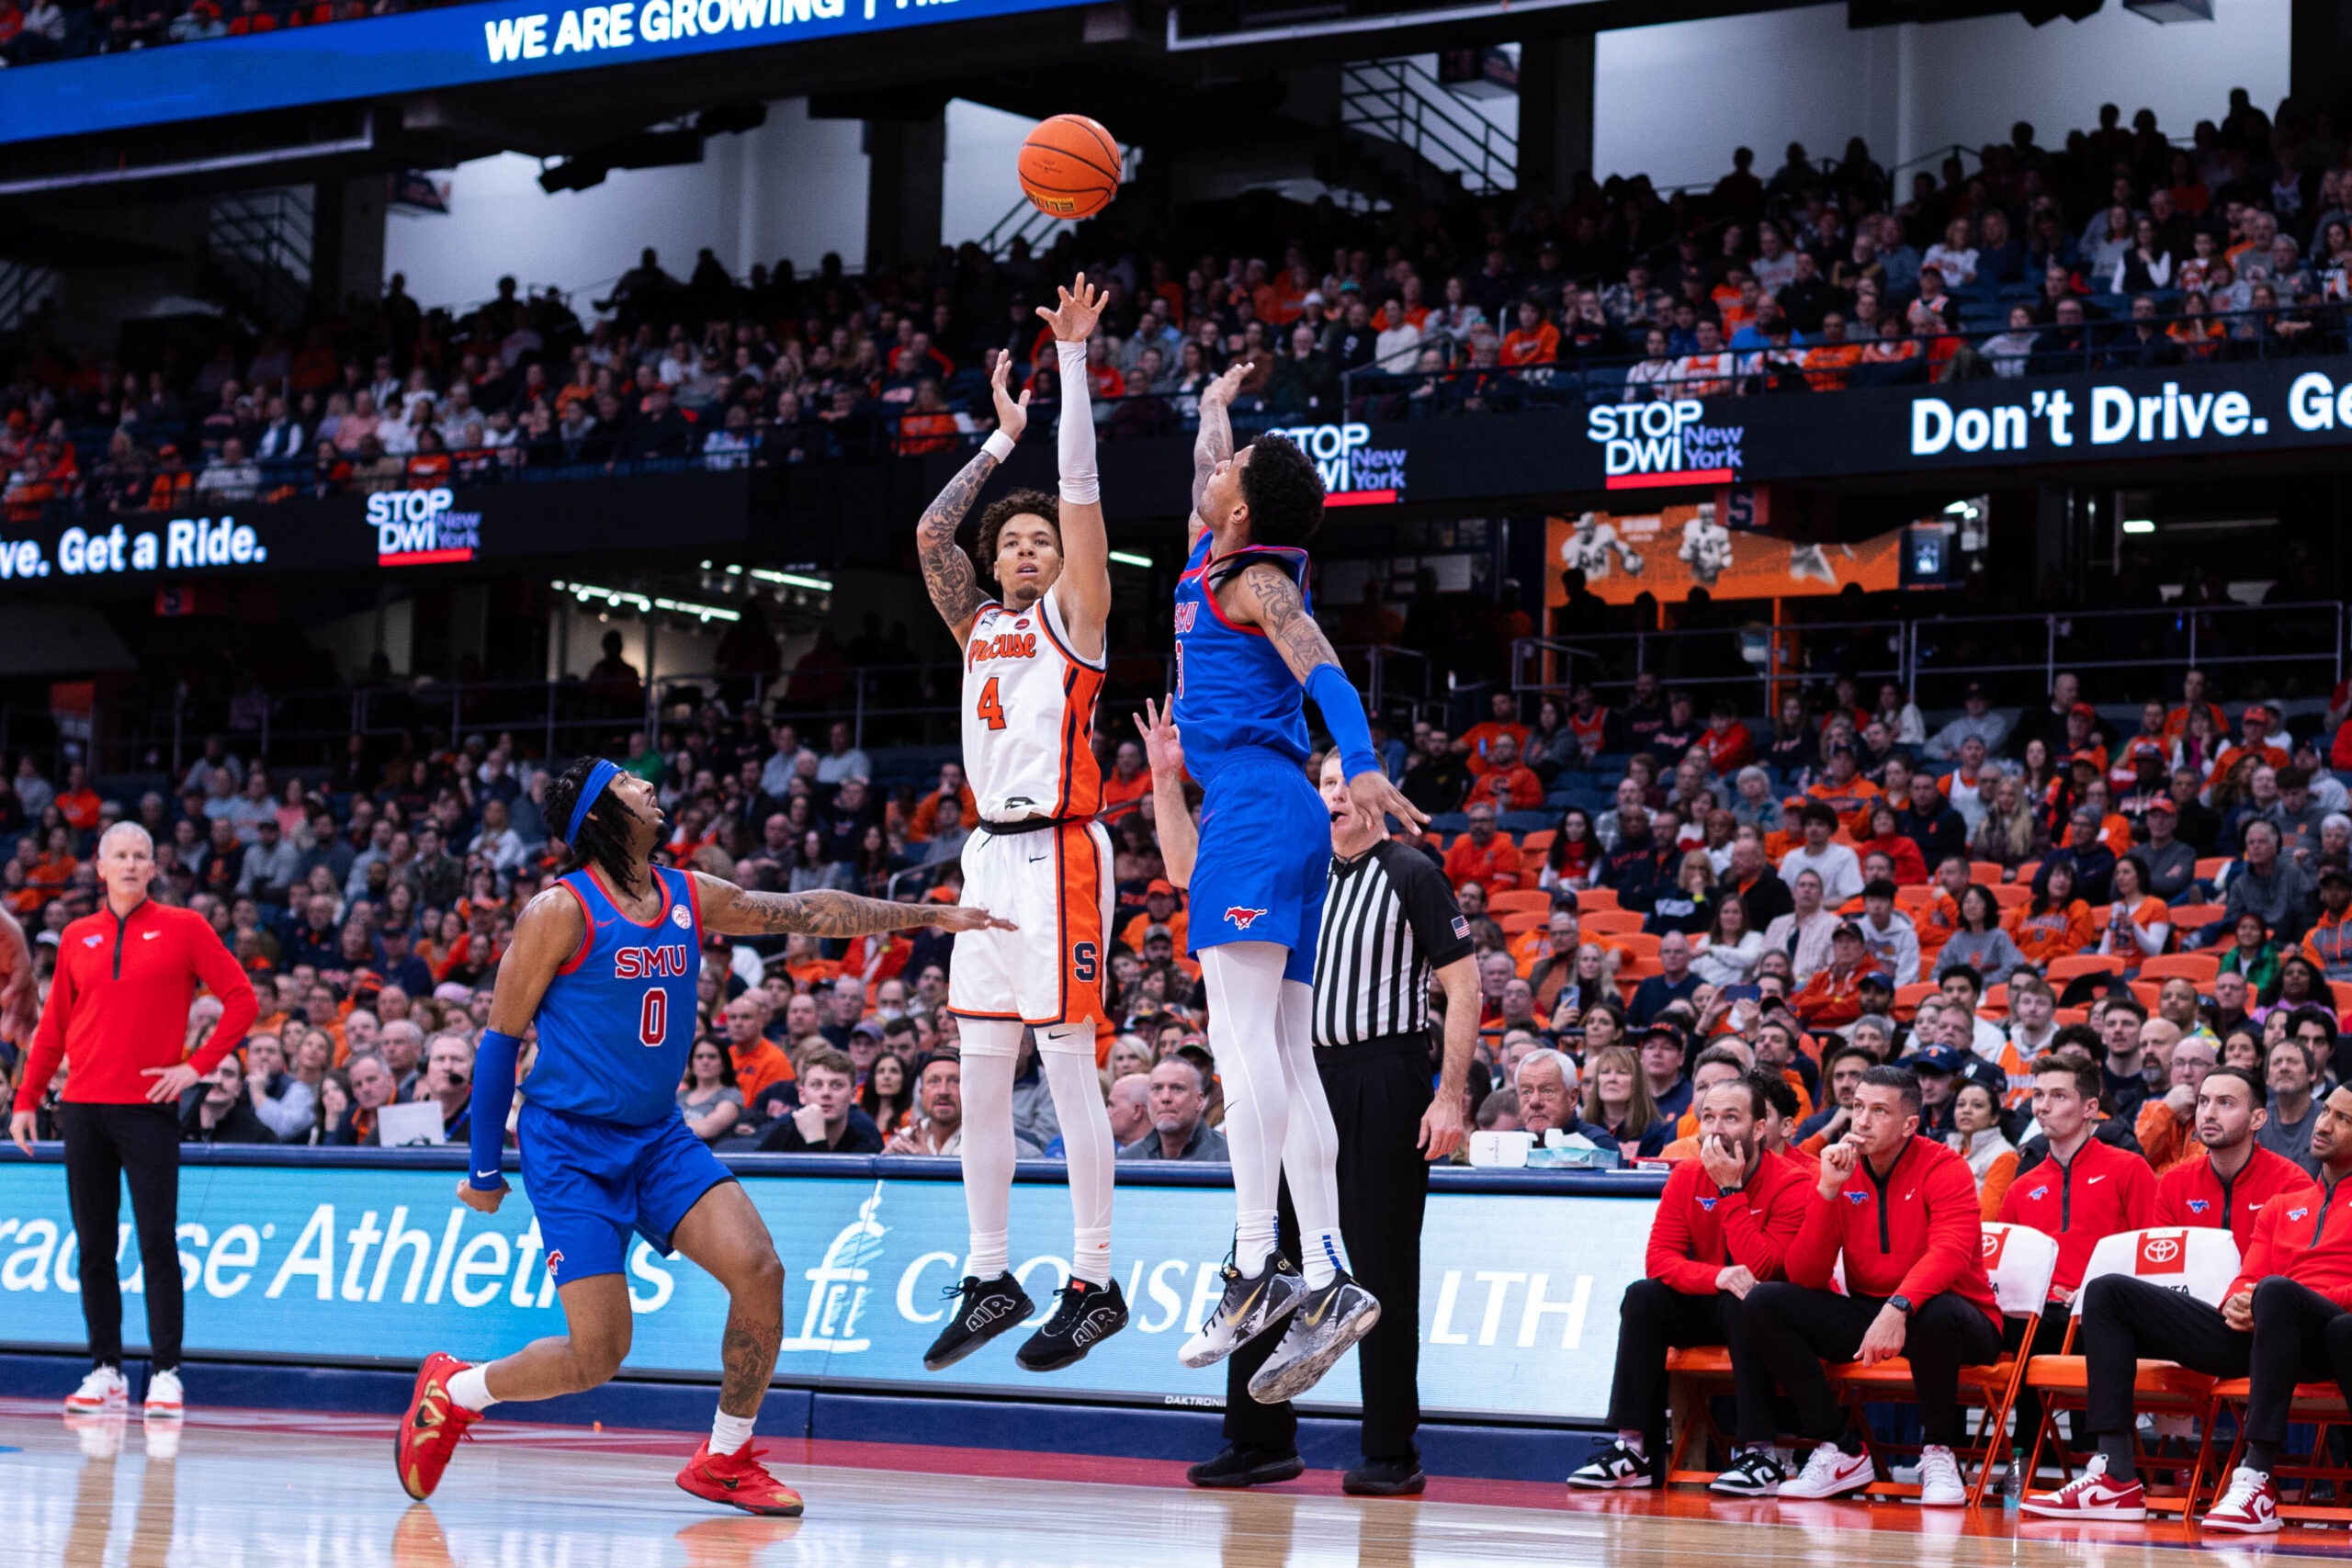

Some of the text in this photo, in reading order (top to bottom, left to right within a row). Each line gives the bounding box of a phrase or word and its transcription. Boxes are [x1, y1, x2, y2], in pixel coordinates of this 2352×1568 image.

[485, 15, 548, 63] WE
[553, 3, 635, 55] ARE
[1587, 399, 1703, 442] STOP
[2090, 381, 2268, 445] Drive.
[1265, 423, 1371, 460] TOP
[1683, 423, 1744, 447] New
[1315, 457, 1350, 492] WI
[1351, 446, 1408, 469] New
[1605, 436, 1682, 476] DWI
[1684, 446, 1743, 469] York
[1351, 467, 1406, 491] York
[366, 487, 454, 527] STOP
[436, 511, 483, 530] New
[58, 524, 128, 575] Get
[131, 531, 159, 571] a
[166, 515, 267, 568] Ride.
[378, 520, 437, 555] DWI
[977, 677, 1008, 731] 4
[615, 945, 687, 979] SMU
[1073, 941, 1098, 983] S
[639, 987, 668, 1047] 0
[965, 1293, 1017, 1333] AIR
[1071, 1306, 1119, 1348] AIR
